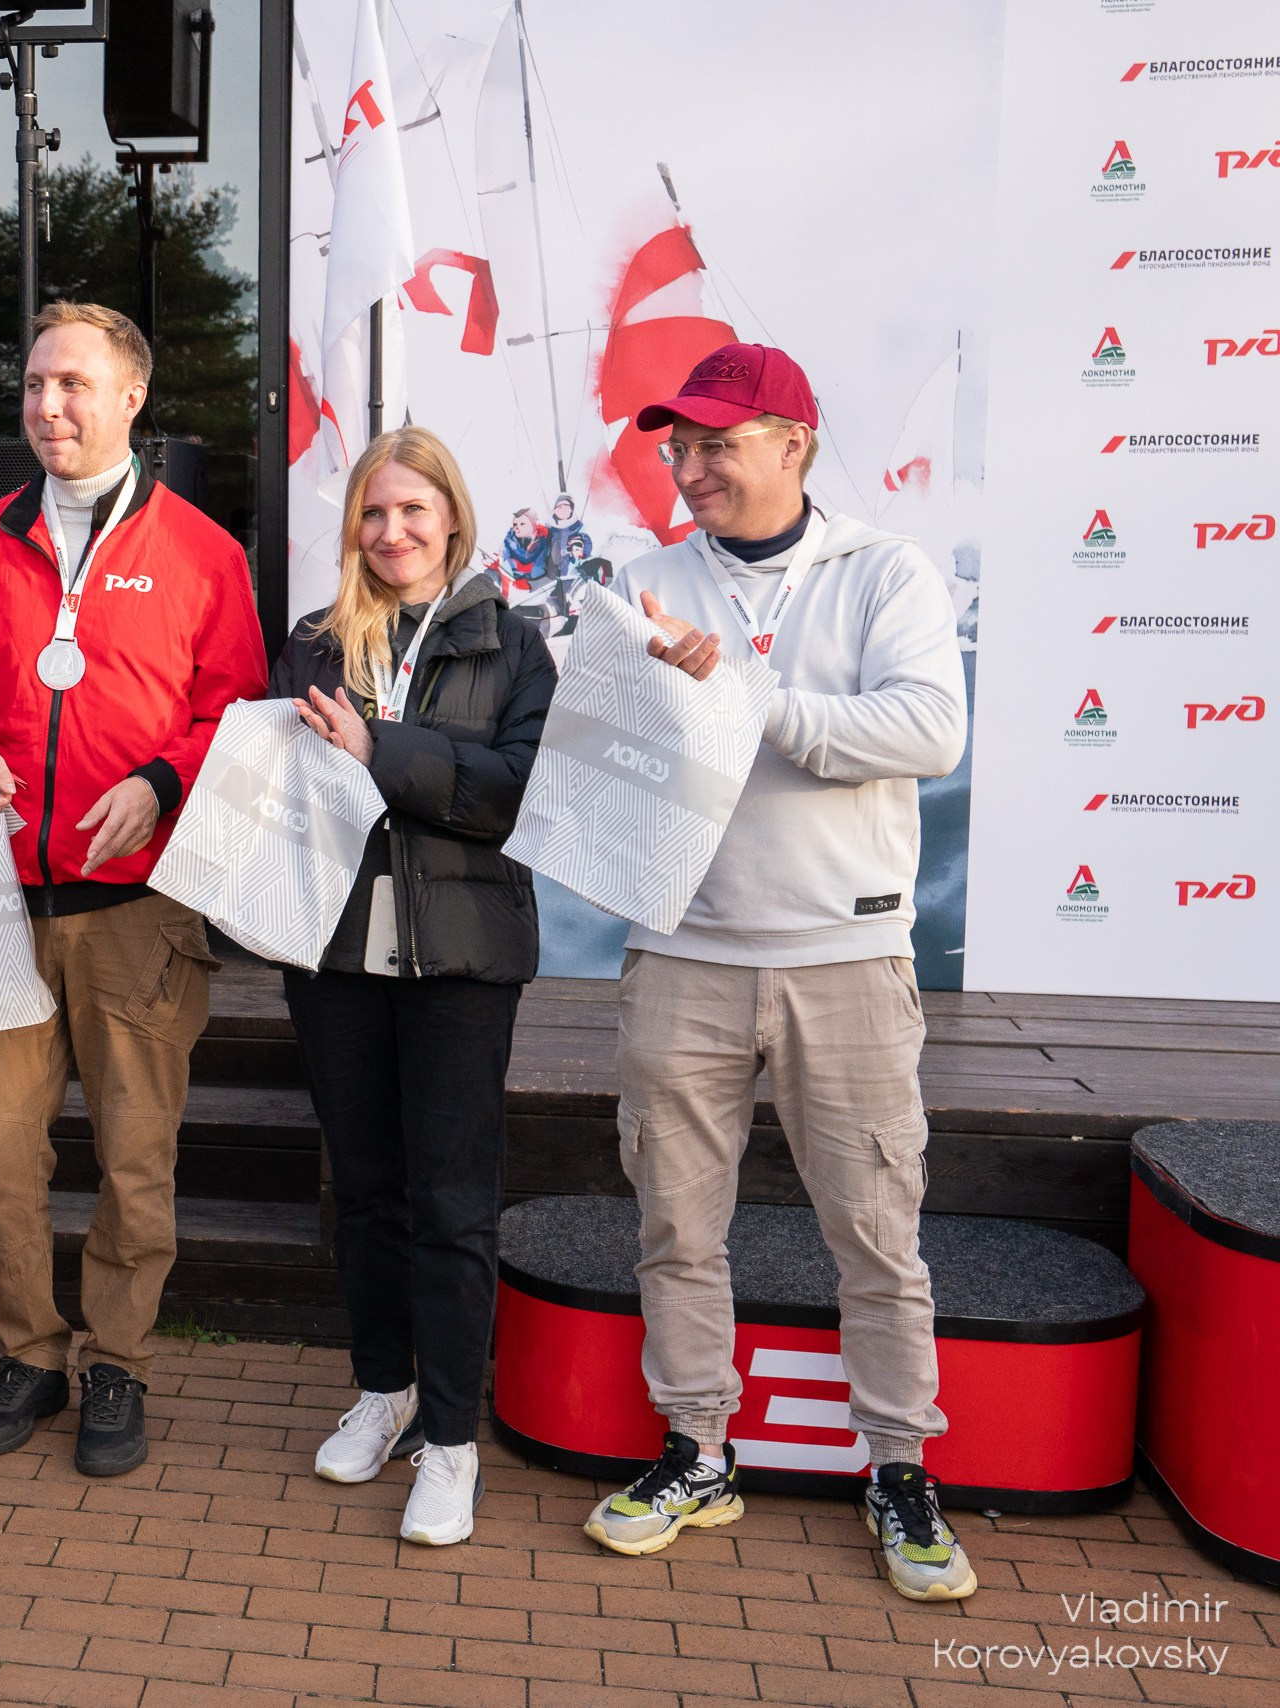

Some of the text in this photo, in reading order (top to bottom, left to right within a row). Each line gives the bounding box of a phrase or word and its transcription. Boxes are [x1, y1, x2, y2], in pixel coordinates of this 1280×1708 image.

[1091, 184, 1146, 192] ЛОКОМОТИВ
[1139, 247, 1271, 261] БЛАГОСОСТОЯНИЕ
[1081, 369, 1136, 377] ЛОКОМОТИВ
[1129, 434, 1260, 446] БЛАГОСОСТОЯНИЕ
[1072, 551, 1126, 559] ЛОКОМОТИВ
[1120, 616, 1249, 627] БЛАГОСОСТОЯНИЕ
[1064, 730, 1117, 738] ЛОКОМОТИВ
[1111, 794, 1240, 807] БЛАГОСОСТОЯНИЕ
[1056, 905, 1109, 913] ЛОКОМОТИВ
